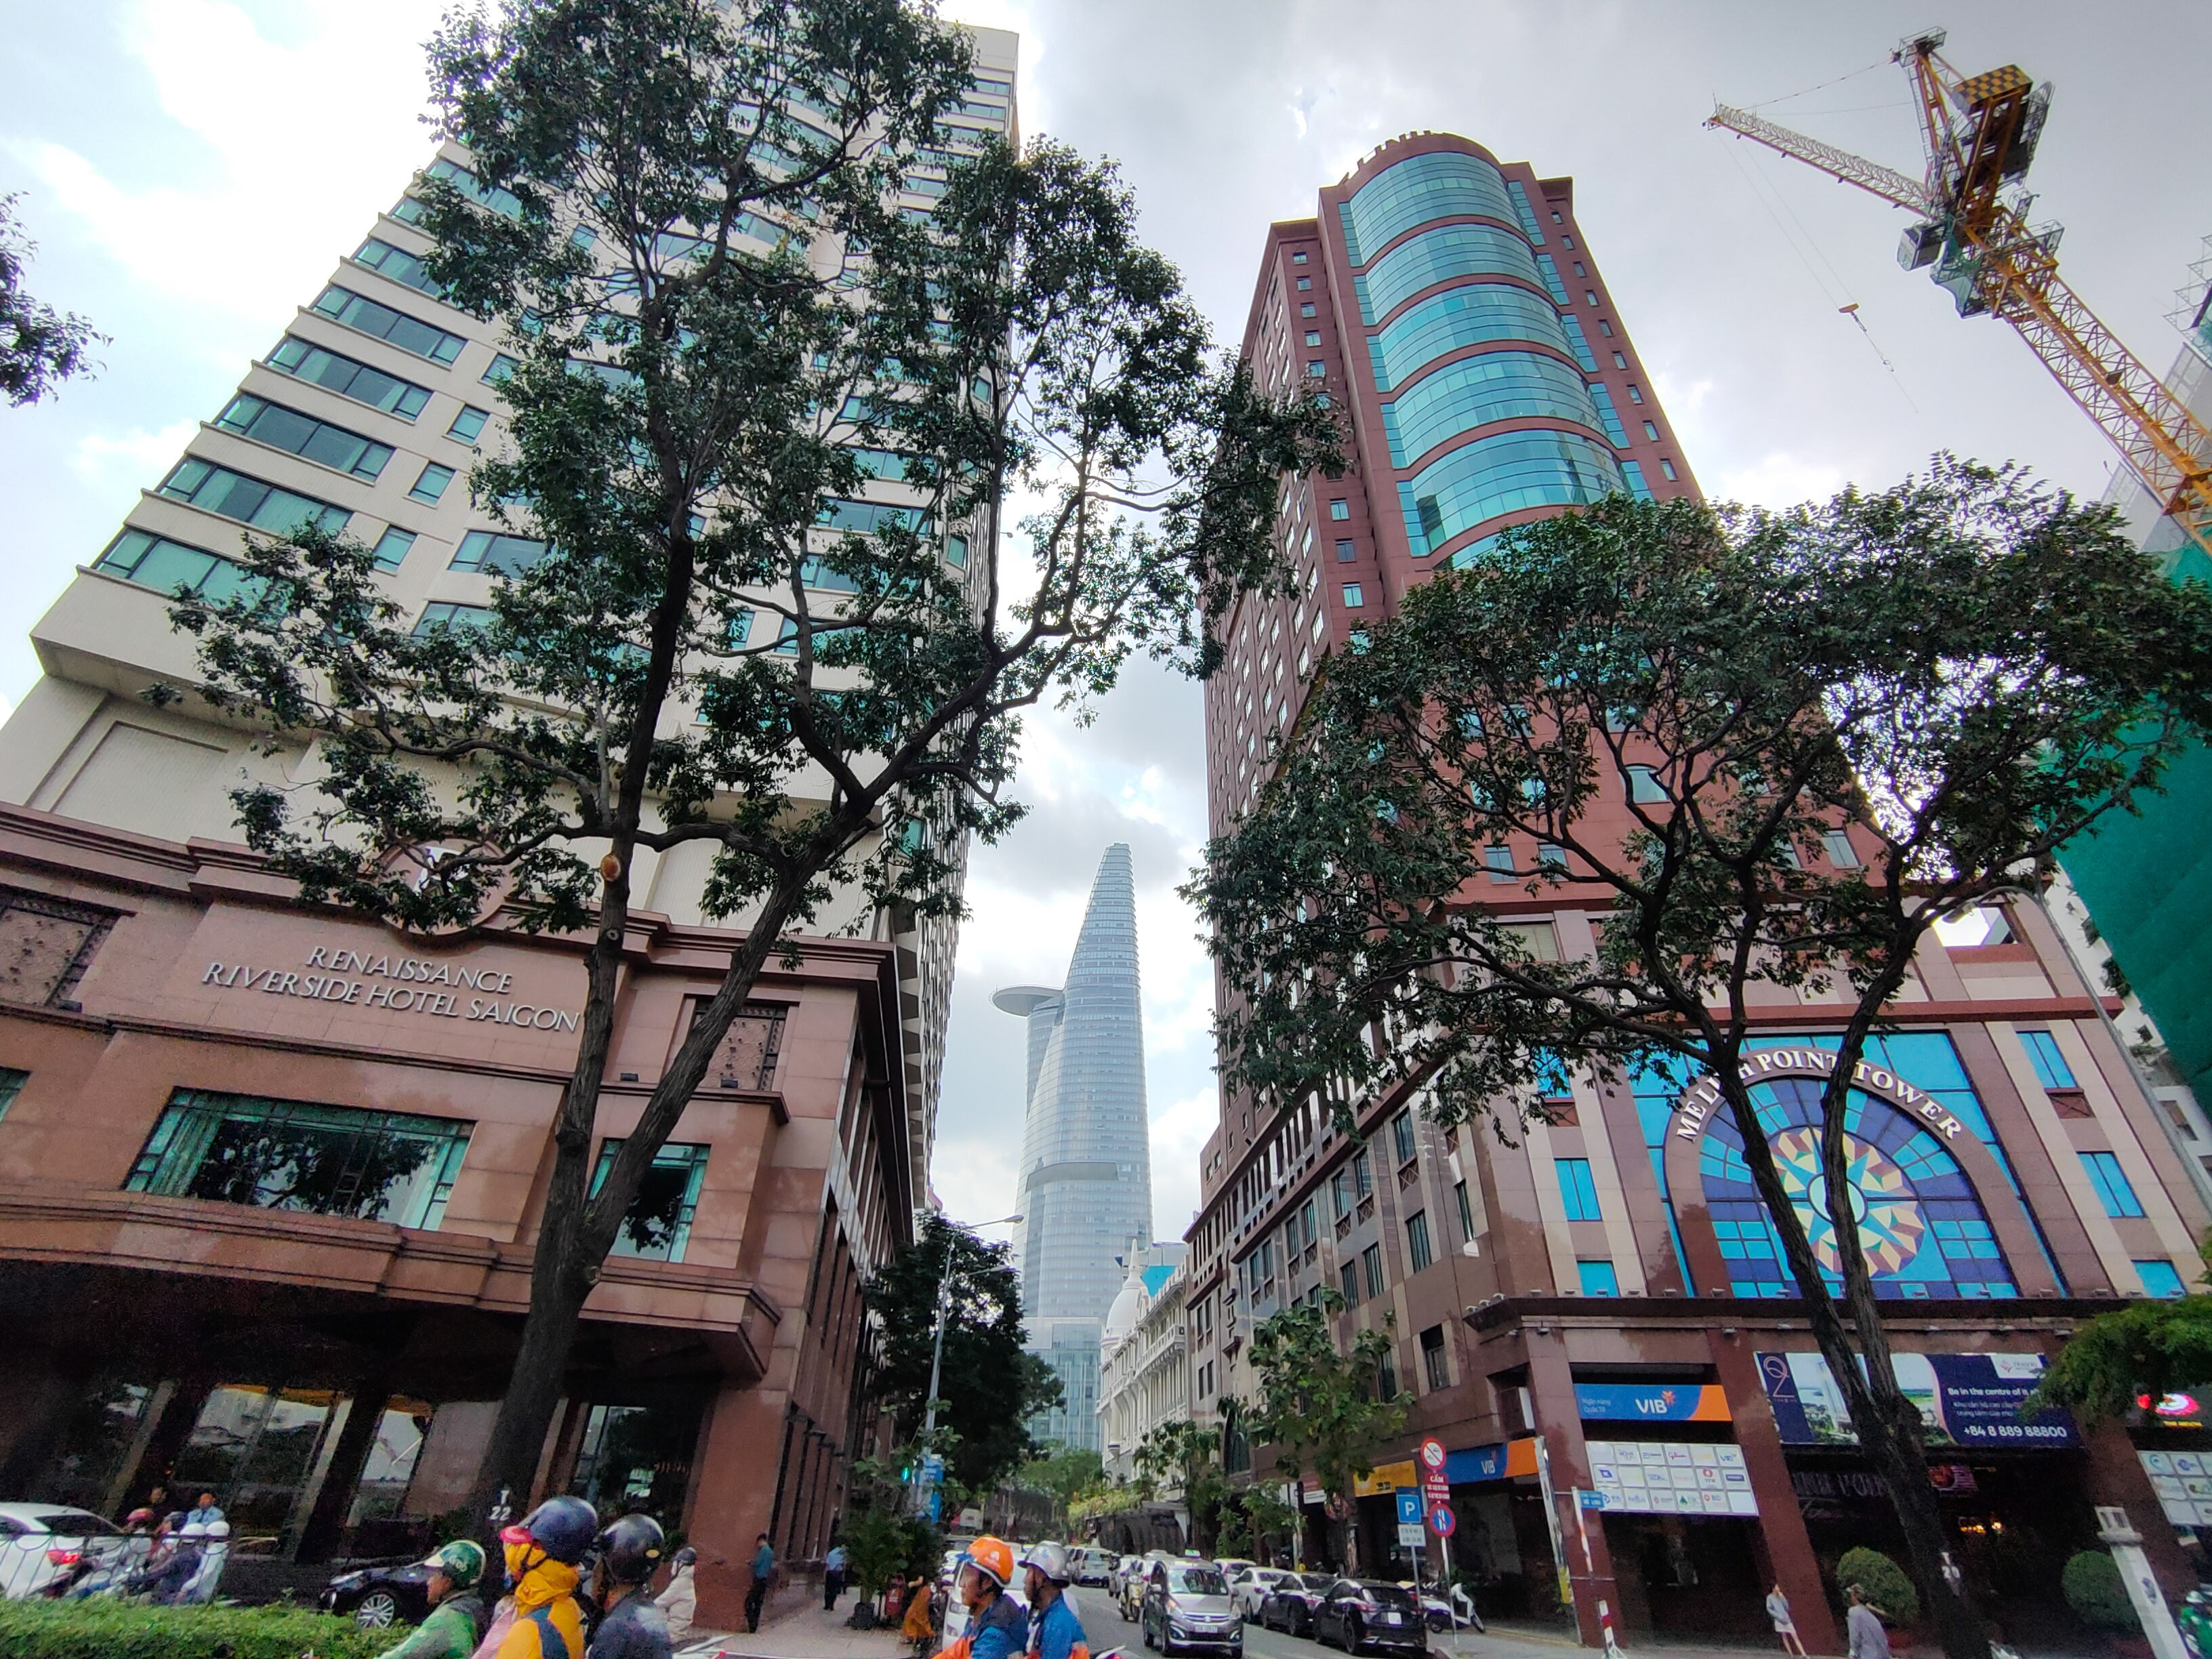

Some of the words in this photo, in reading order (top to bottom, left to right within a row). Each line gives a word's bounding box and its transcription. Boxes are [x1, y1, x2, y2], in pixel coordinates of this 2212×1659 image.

[305, 945, 513, 994] RENAISSANCE
[201, 962, 361, 1004] RIVERSIDE
[364, 984, 459, 1017] HOTEL
[466, 998, 580, 1033] SAIGON
[1856, 1061, 1962, 1140] TOWER
[1635, 1399, 1667, 1414] VIB
[1964, 1426, 1986, 1436] +84
[1988, 1426, 1996, 1437] 8
[1999, 1426, 2022, 1437] 889
[2025, 1426, 2067, 1437] 88800
[1481, 1460, 1496, 1475] VIB
[489, 1506, 512, 1521] 22
[1405, 1501, 1416, 1516] P
